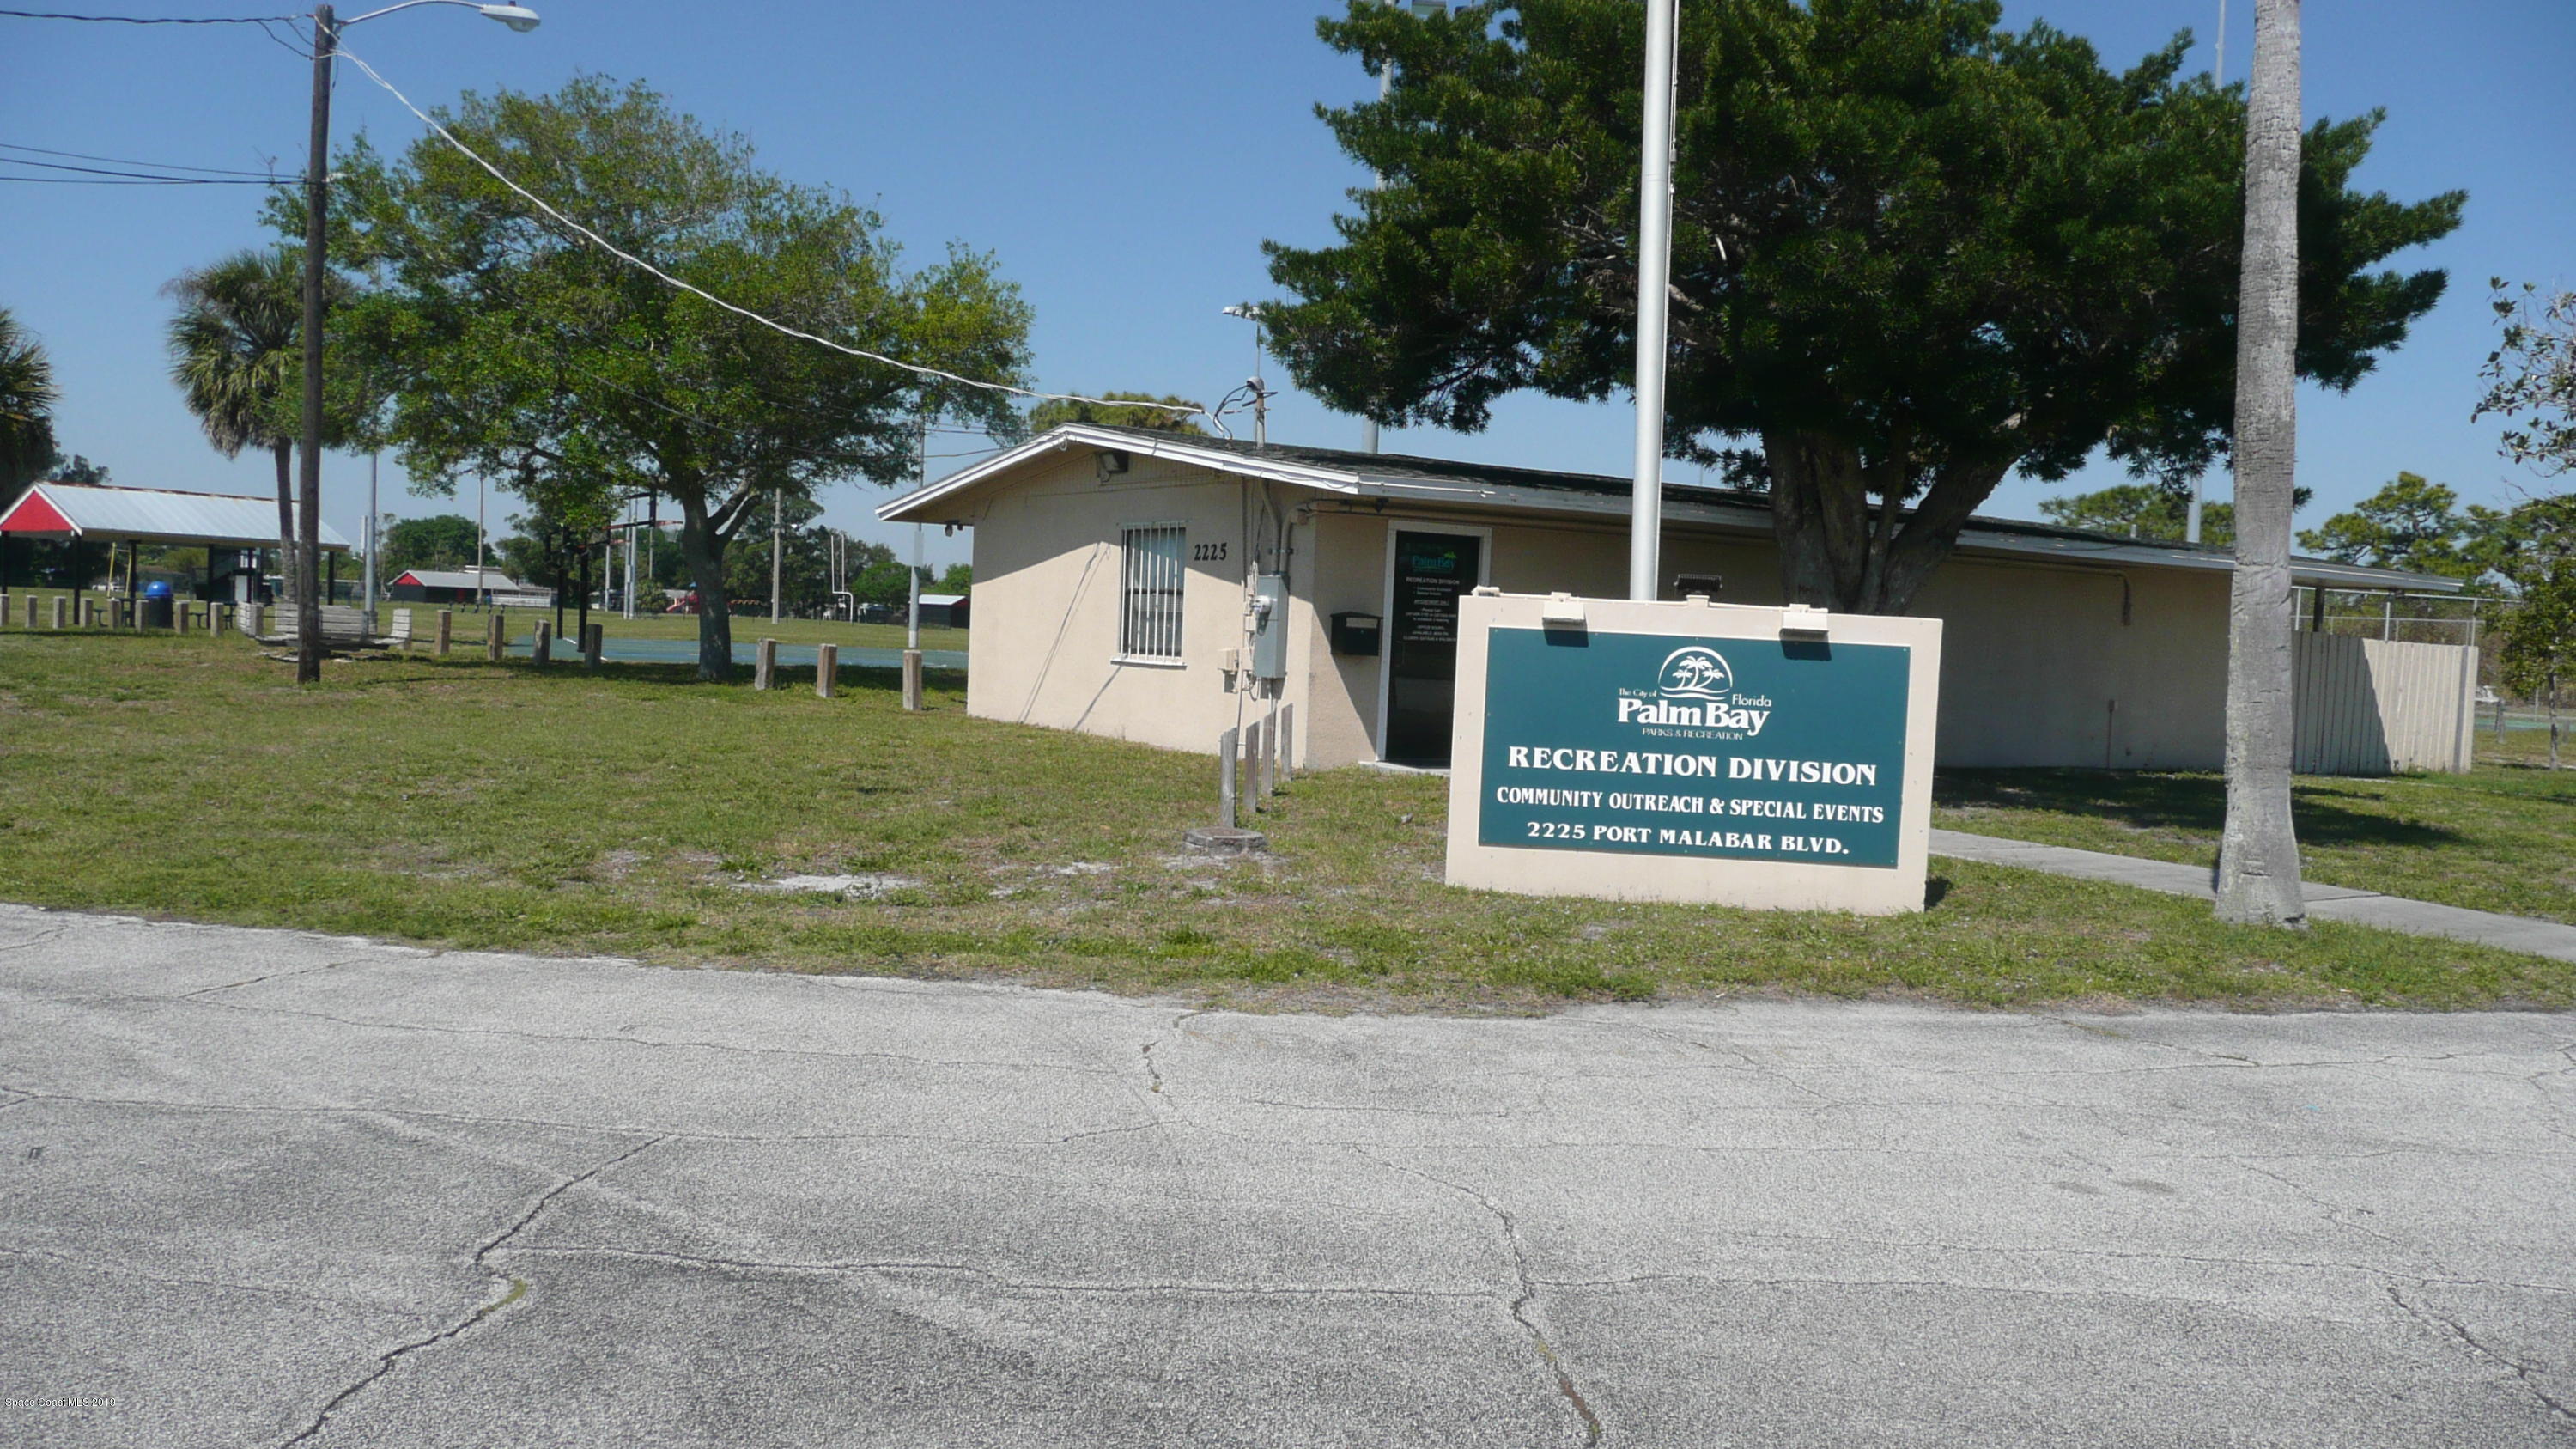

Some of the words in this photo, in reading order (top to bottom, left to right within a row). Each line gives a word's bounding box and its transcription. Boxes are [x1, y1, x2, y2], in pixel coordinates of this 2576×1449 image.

[1194, 542, 1227, 561] 2225
[1619, 688, 1631, 697] The
[1632, 689, 1648, 697] City
[1732, 694, 1772, 707] Florida
[1617, 698, 1702, 726] Palm
[1704, 702, 1771, 736] Bay
[1642, 728, 1673, 737] PARKS
[1683, 730, 1743, 740] RECREATION
[1508, 746, 1716, 777] RECREATION
[1728, 757, 1877, 786] DIVISION
[1497, 786, 1603, 808] COMMUNITY
[1608, 792, 1704, 813] OUTREACH
[1709, 798, 1725, 814] &
[1729, 798, 1807, 819] SPECIAL
[1813, 803, 1884, 823] EVENTS
[1527, 821, 1586, 839] 2225
[1594, 825, 1652, 843] PORT
[1659, 829, 1772, 849] MALABAR
[1781, 835, 1850, 855] BLVD.
